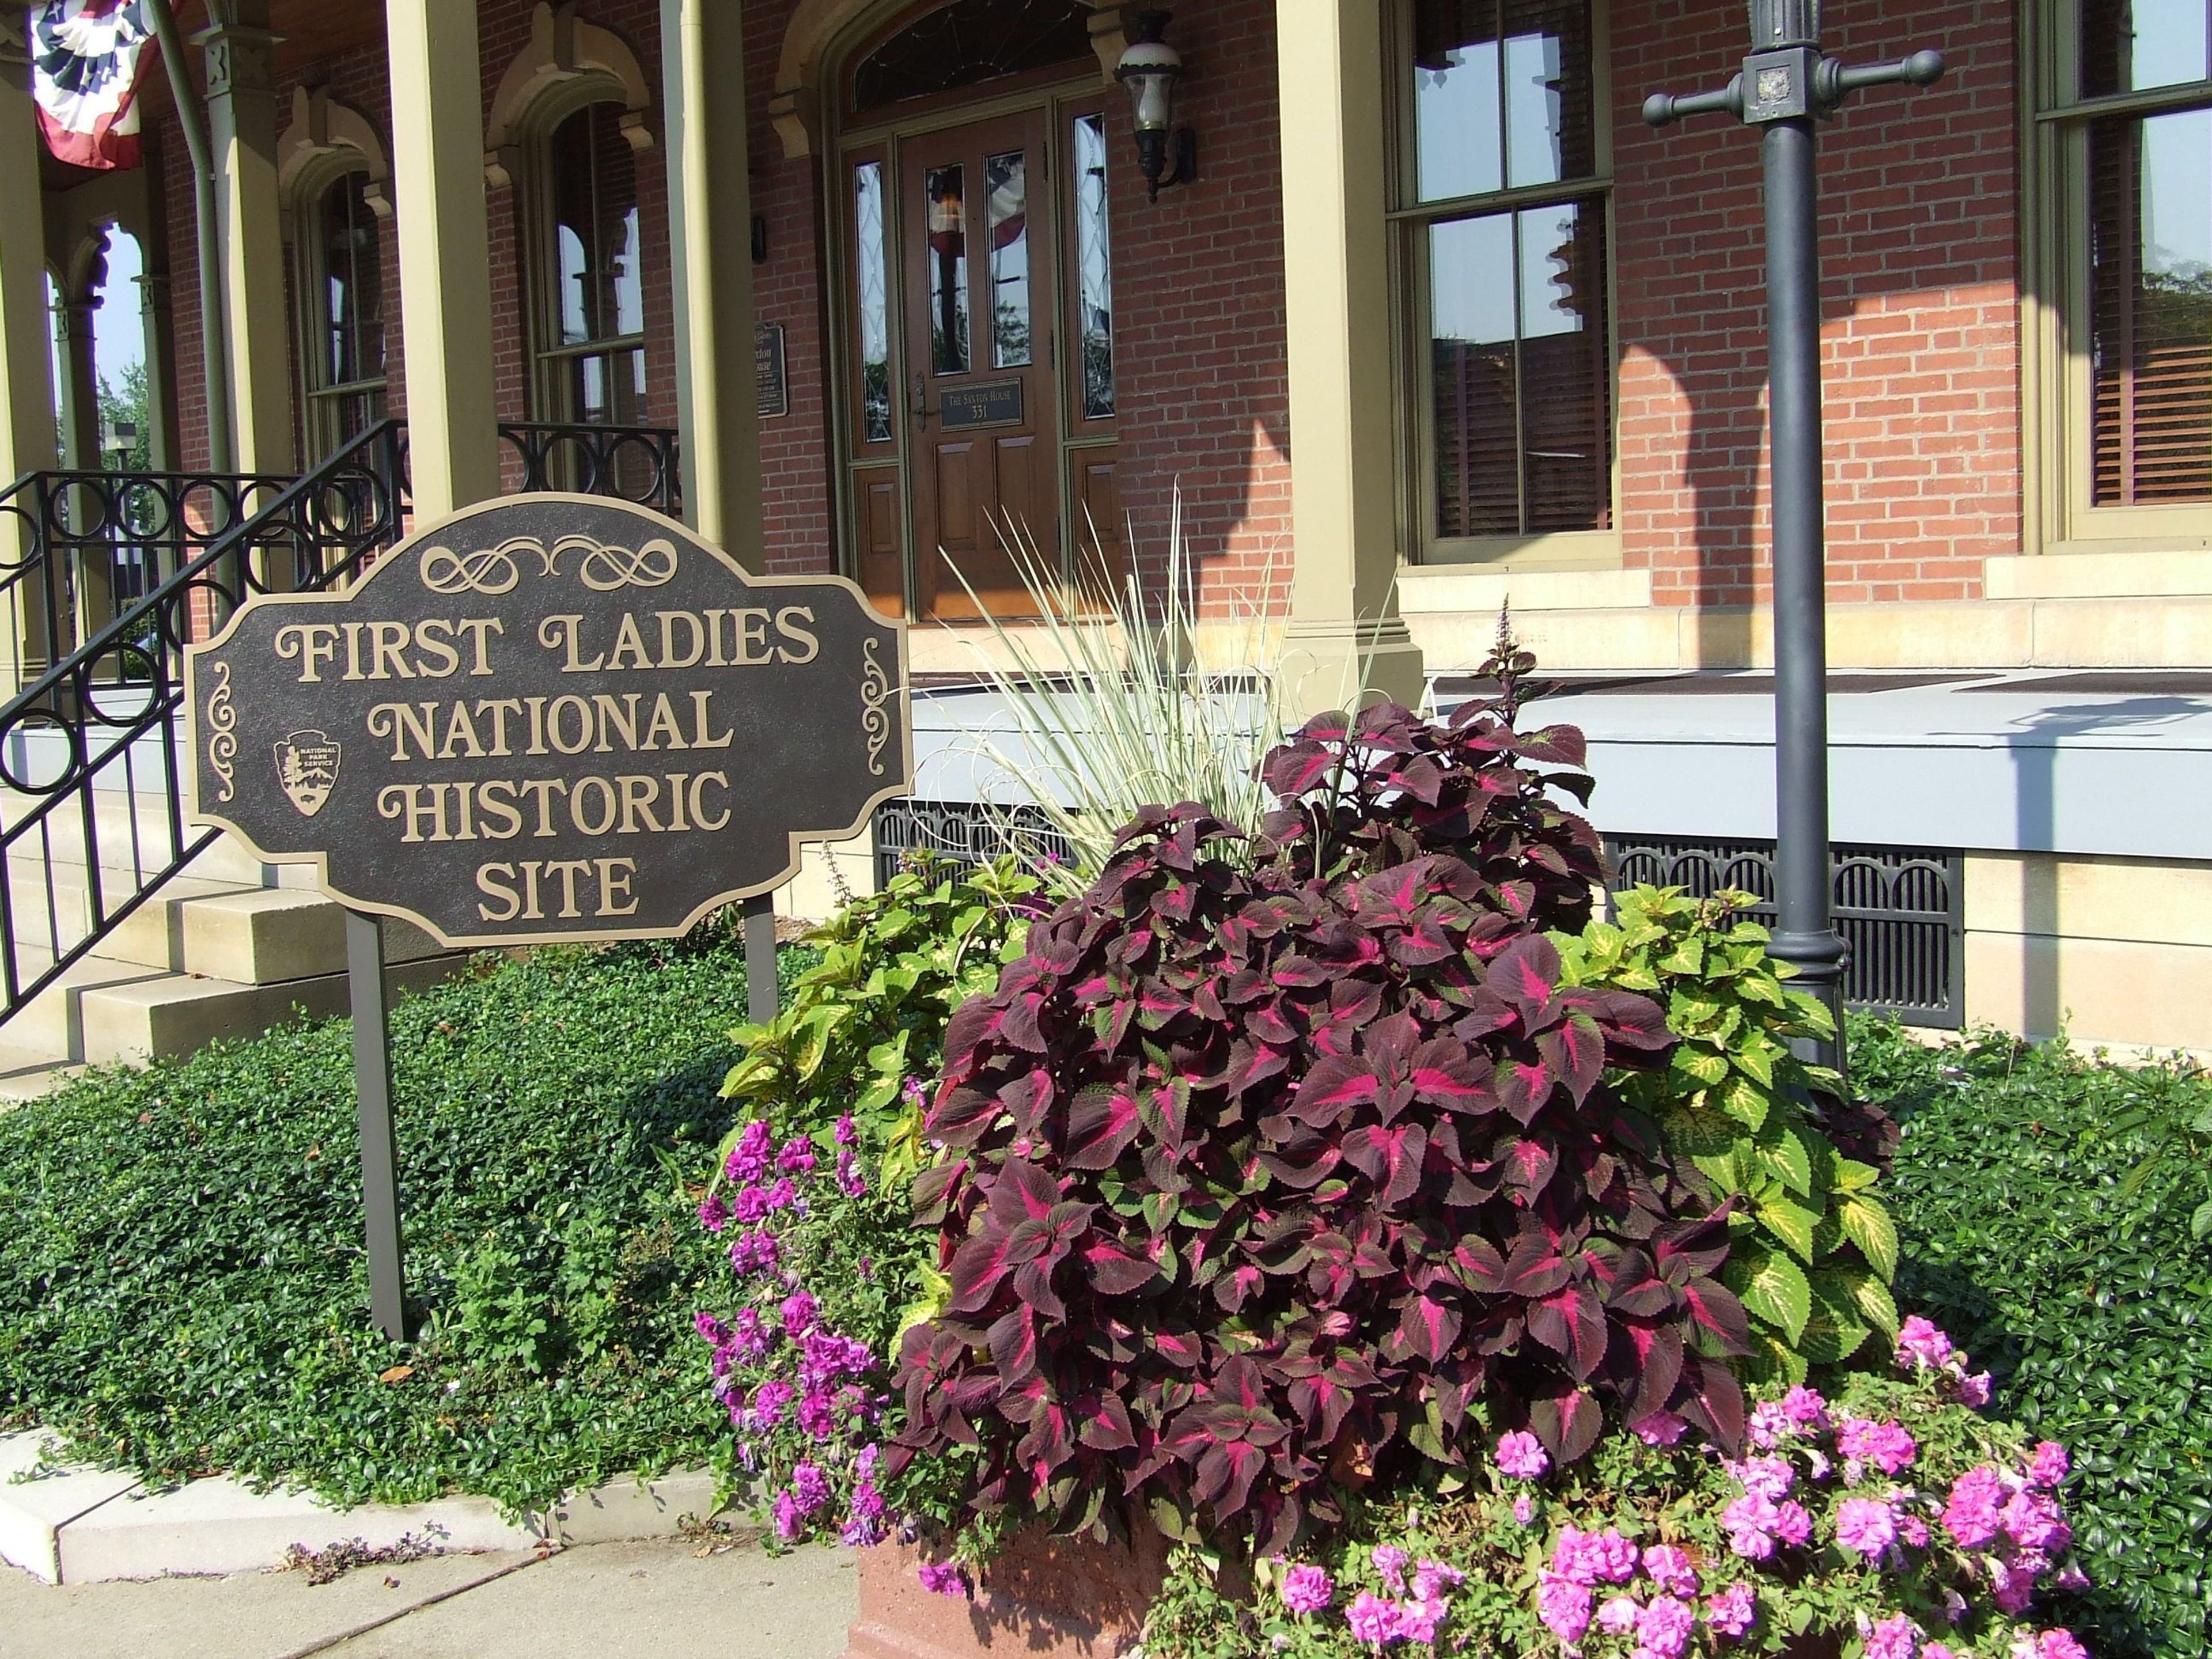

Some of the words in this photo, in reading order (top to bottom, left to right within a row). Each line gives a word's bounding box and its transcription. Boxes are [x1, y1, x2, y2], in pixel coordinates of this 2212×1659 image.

[949, 396, 961, 406] THE
[963, 393, 988, 405] SAXTON
[990, 391, 1011, 402] HOUSE
[972, 404, 987, 418] 331
[274, 617, 503, 682] FIRST
[538, 607, 819, 672] LADIES
[367, 691, 734, 760] NATIONAL
[377, 771, 730, 842] HISTORIC
[476, 858, 639, 921] SITE
